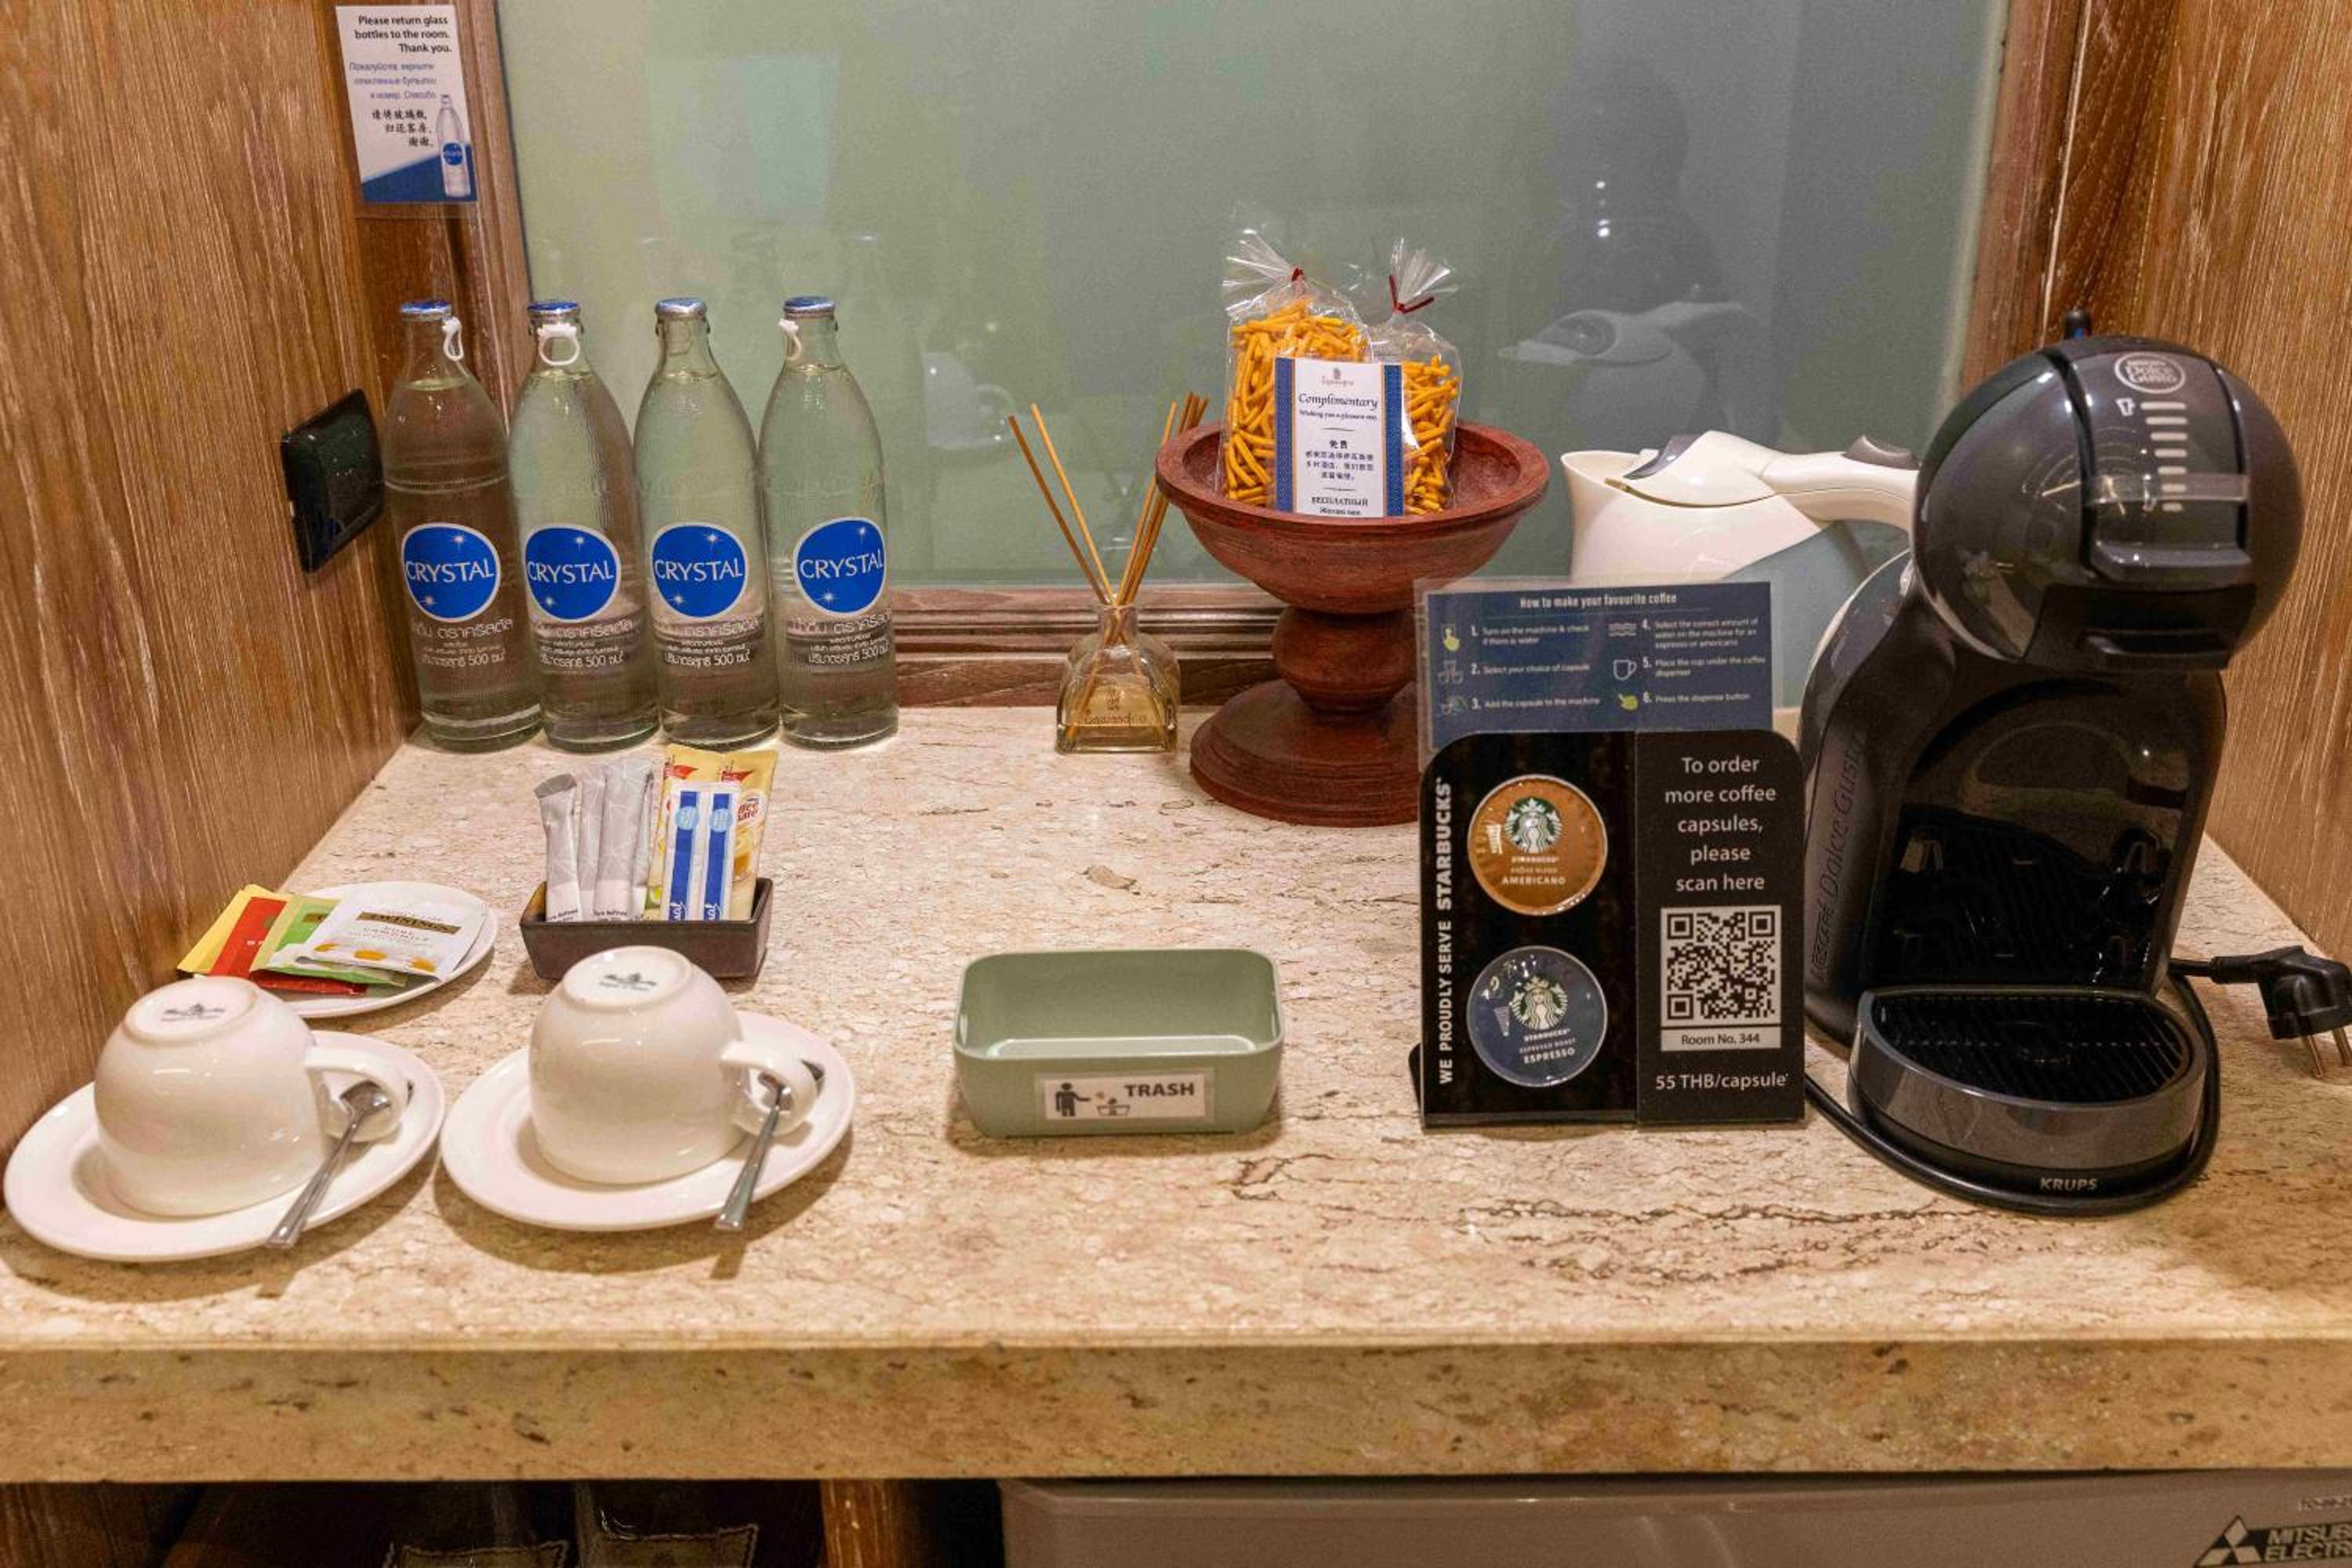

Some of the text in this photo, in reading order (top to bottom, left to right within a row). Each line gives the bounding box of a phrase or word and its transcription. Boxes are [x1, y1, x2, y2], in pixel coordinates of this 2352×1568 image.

[358, 14, 448, 27] Please return glass
[354, 30, 389, 38] bottles
[403, 30, 419, 38] the
[398, 42, 452, 54] Thank you.
[1298, 393, 1377, 412] Complimentary
[405, 558, 495, 583] CRYSTAL
[655, 557, 744, 583] CRYSTAL
[800, 548, 884, 579] CRYSTAL
[528, 560, 615, 584] CRYSTAL
[1520, 592, 1677, 609] How to make your favourite coffee
[1525, 626, 1557, 634] machine
[1642, 616, 1759, 630] 4. Select the correct amount of
[1689, 629, 1700, 637] the
[1702, 628, 1733, 637] machine
[1699, 638, 1739, 648] americano
[861, 645, 878, 659] 500
[468, 654, 488, 666] 500
[585, 655, 606, 667] 500
[713, 653, 735, 666] 500
[1642, 655, 1766, 668] 5. Place the cup under the coffee
[1471, 662, 1481, 675] 2.
[1561, 664, 1590, 673] capsule
[1472, 697, 1481, 710] 3.
[1515, 699, 1544, 708] capsule
[1567, 696, 1600, 706] machine
[1642, 691, 1751, 703] 6. Press the dispense button
[1680, 755, 1760, 774] To order
[1664, 785, 1777, 804] more coffee
[1677, 814, 1763, 837] capsules,
[1690, 844, 1751, 866] please
[1501, 876, 1566, 885] AMERICANO
[1676, 872, 1765, 891] scan here
[371, 913, 450, 931] TWININGS
[1438, 920, 1452, 975] SERVE
[1439, 978, 1453, 1052] PROUDLY
[1681, 1033, 1760, 1046] Room No. 344
[1523, 1047, 1575, 1065] ESPRESSO
[1439, 1058, 1453, 1084] WE
[1124, 1082, 1195, 1097] TRASH
[1655, 1075, 1676, 1091] 55
[2040, 1177, 2098, 1191] KRUPS
